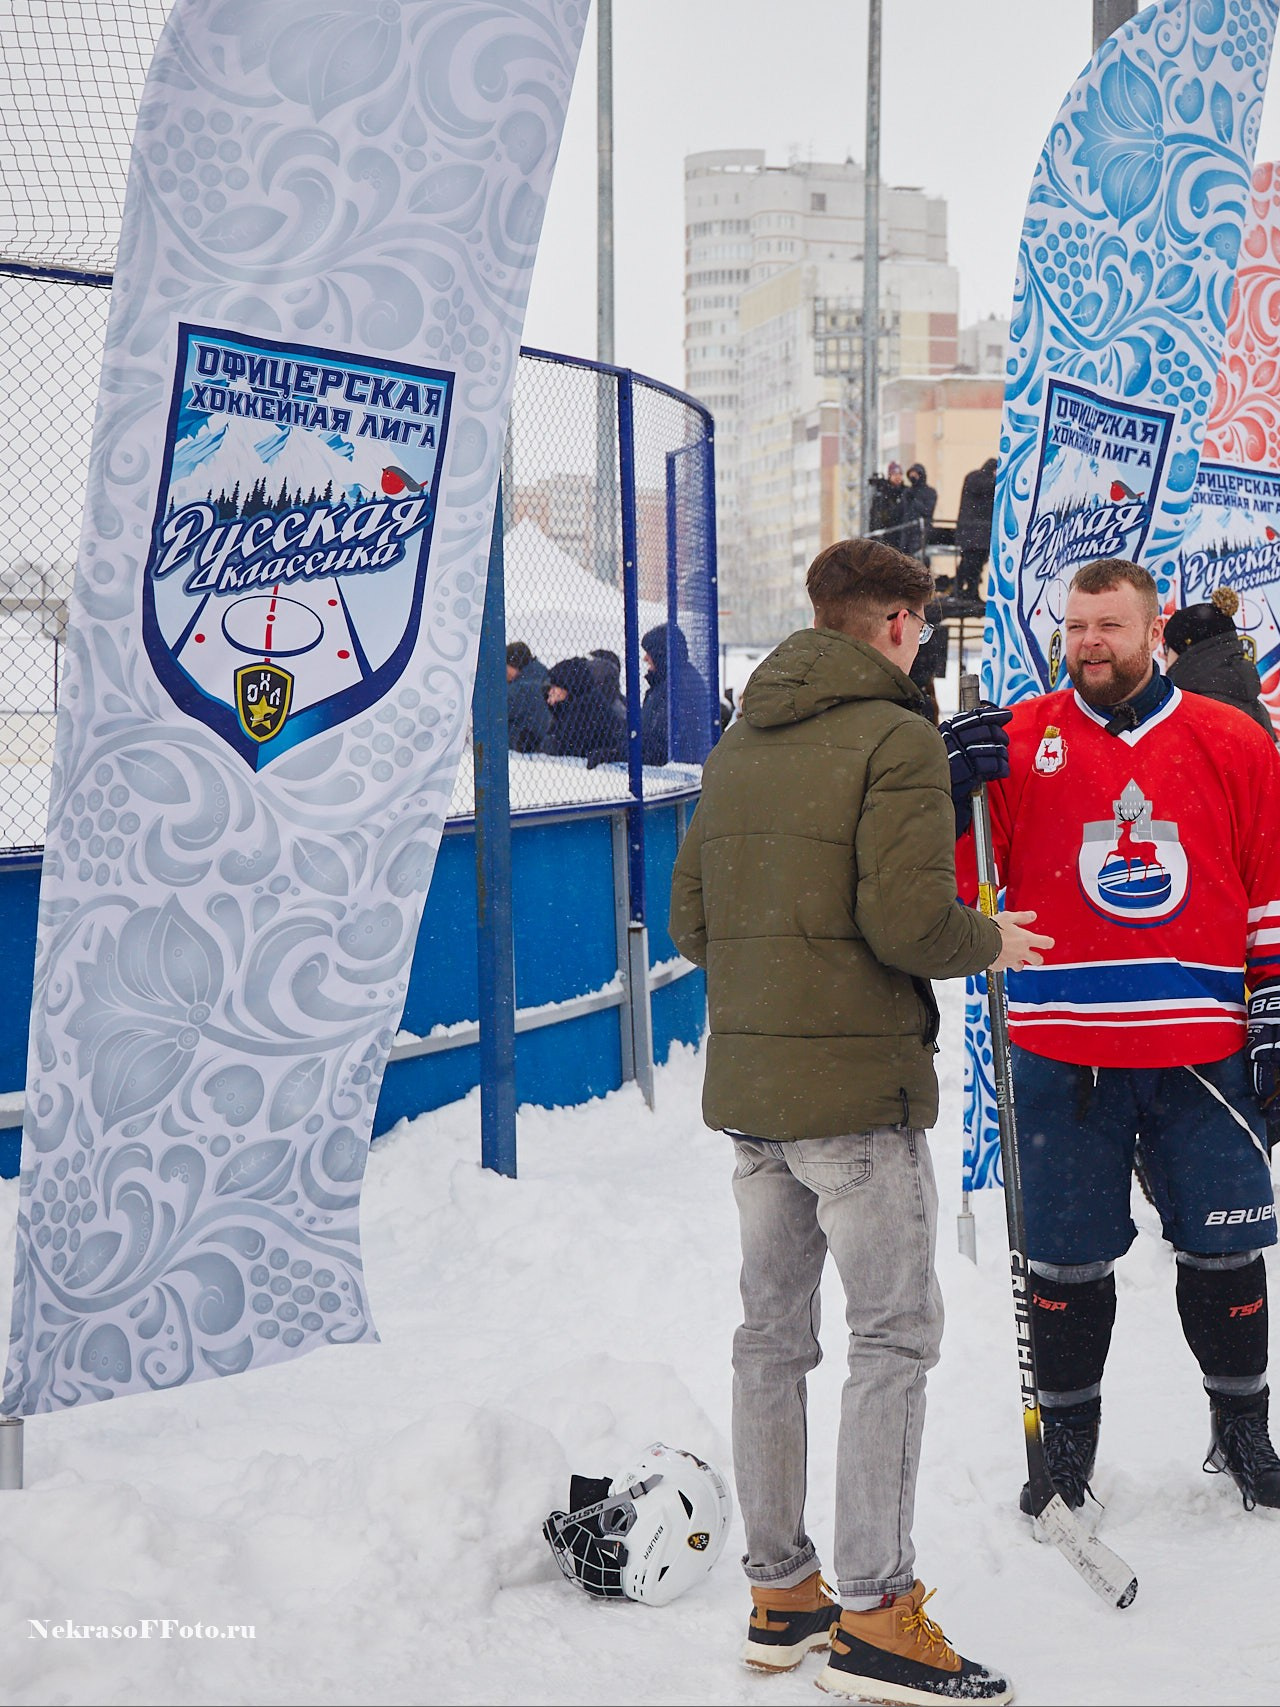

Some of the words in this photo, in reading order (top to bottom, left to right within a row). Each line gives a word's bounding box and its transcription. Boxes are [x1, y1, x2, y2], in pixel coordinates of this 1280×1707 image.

[193, 342, 443, 417] ОФИЦЕРСКАЯ
[188, 382, 352, 433] ХОККЕЙНАЯ
[357, 411, 435, 449] ЛИГА
[1102, 441, 1152, 468] ЛИГА
[1192, 492, 1249, 509] ОККЕЙНАЯ
[158, 499, 427, 589] Русская
[563, 1502, 604, 1527] EASTON
